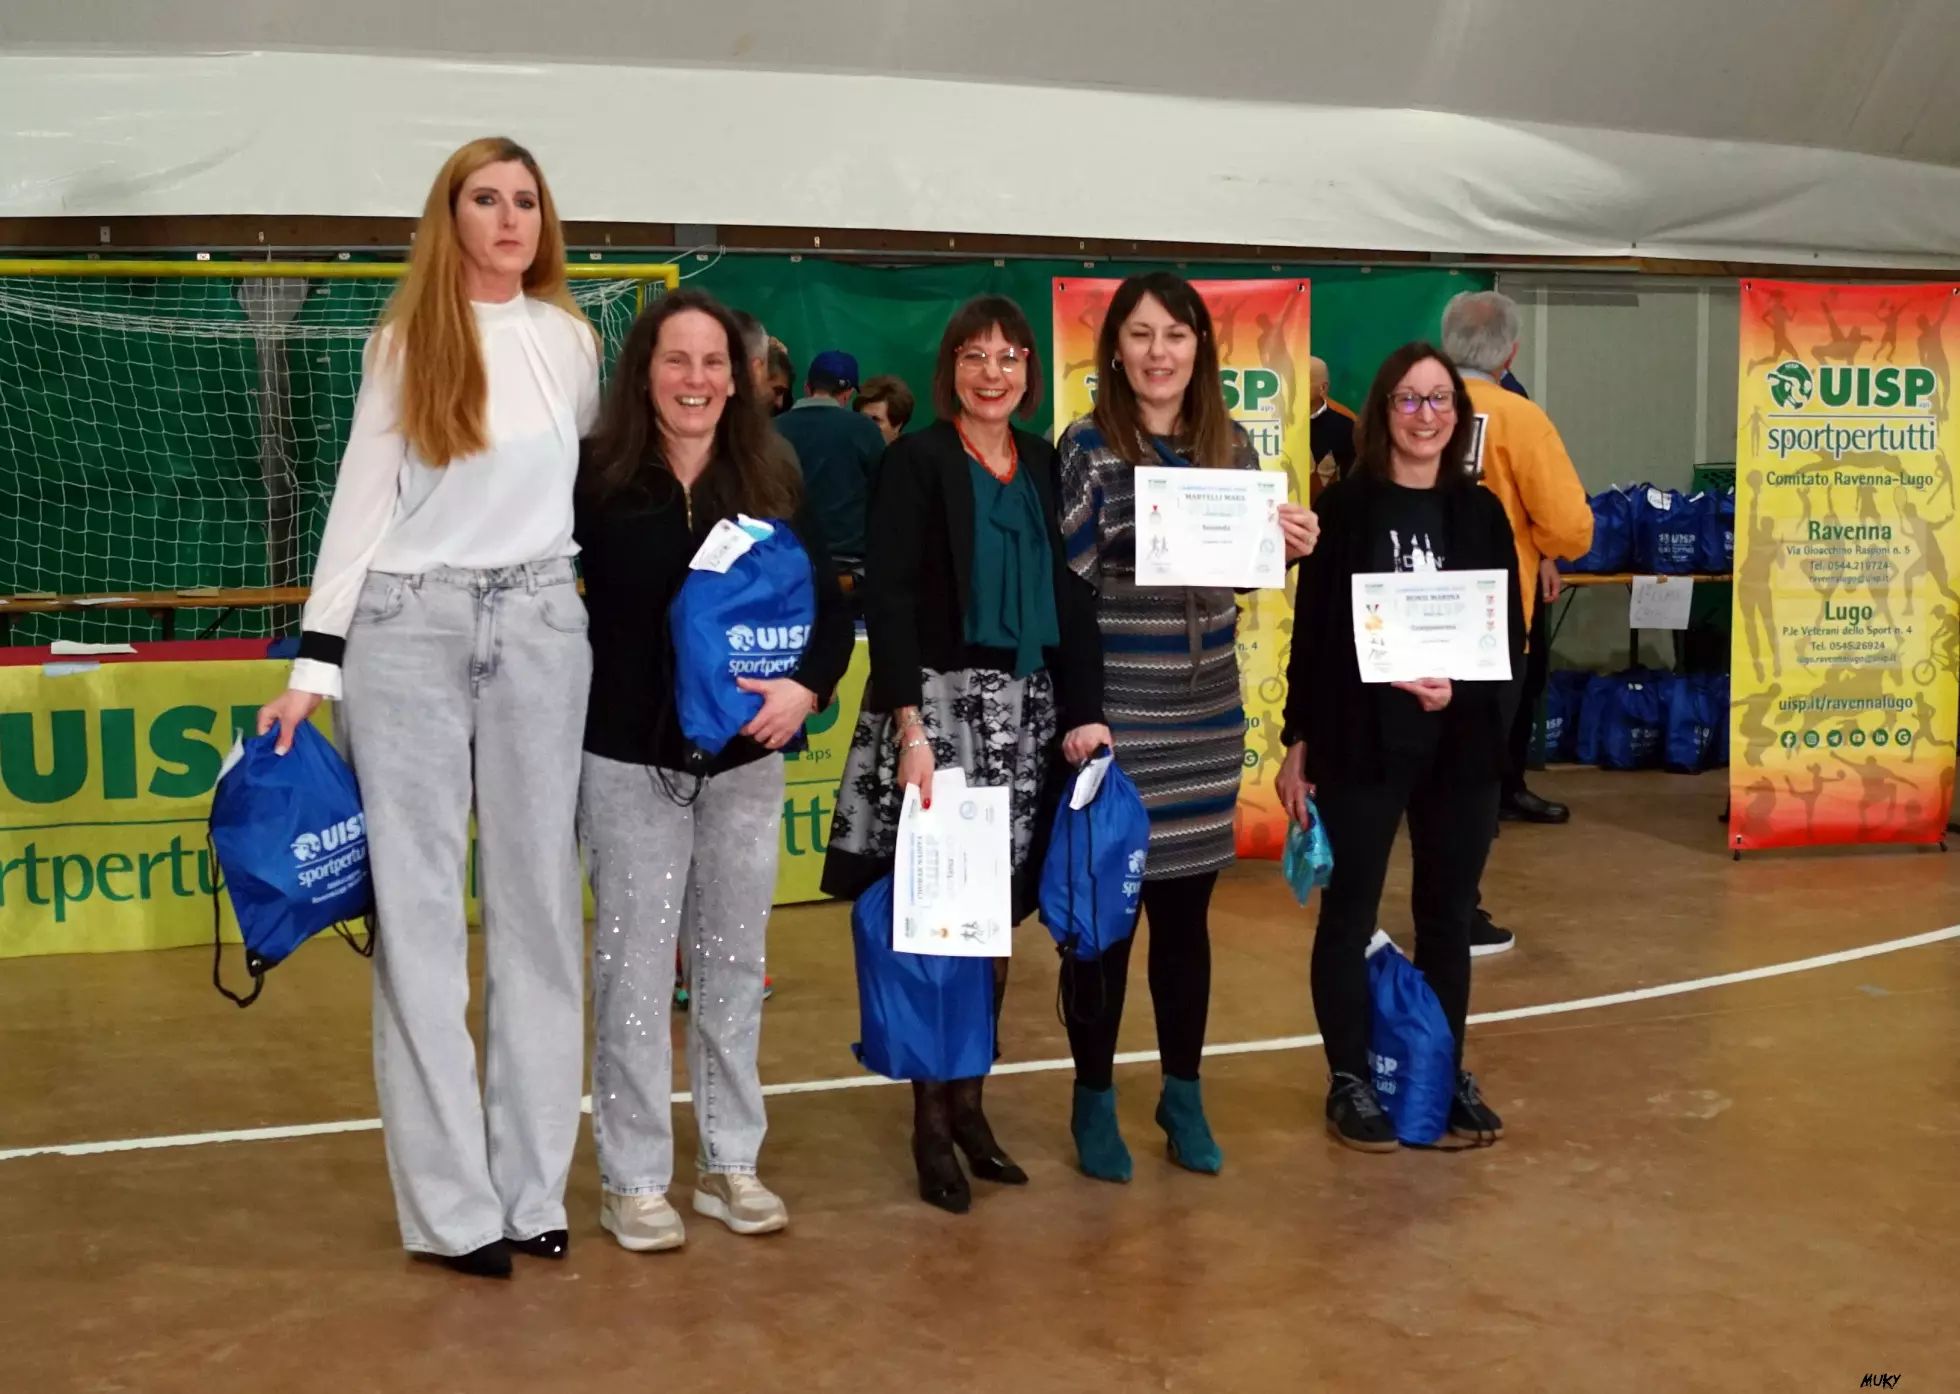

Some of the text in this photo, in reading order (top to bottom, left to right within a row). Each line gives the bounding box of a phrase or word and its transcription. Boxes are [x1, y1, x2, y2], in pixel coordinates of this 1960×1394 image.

[1820, 368, 1935, 408] UISP
[1768, 421, 1935, 459] sportpertutti
[1766, 471, 1934, 489] Comitato Ravenna-Lugo
[1808, 520, 1892, 540] Ravenna
[1786, 546, 1801, 555] Via
[1825, 601, 1873, 625] Lugo
[1868, 626, 1892, 637] Sport
[1778, 694, 1913, 713] uisp.it/ravennalugo
[805, 750, 832, 763] aps
